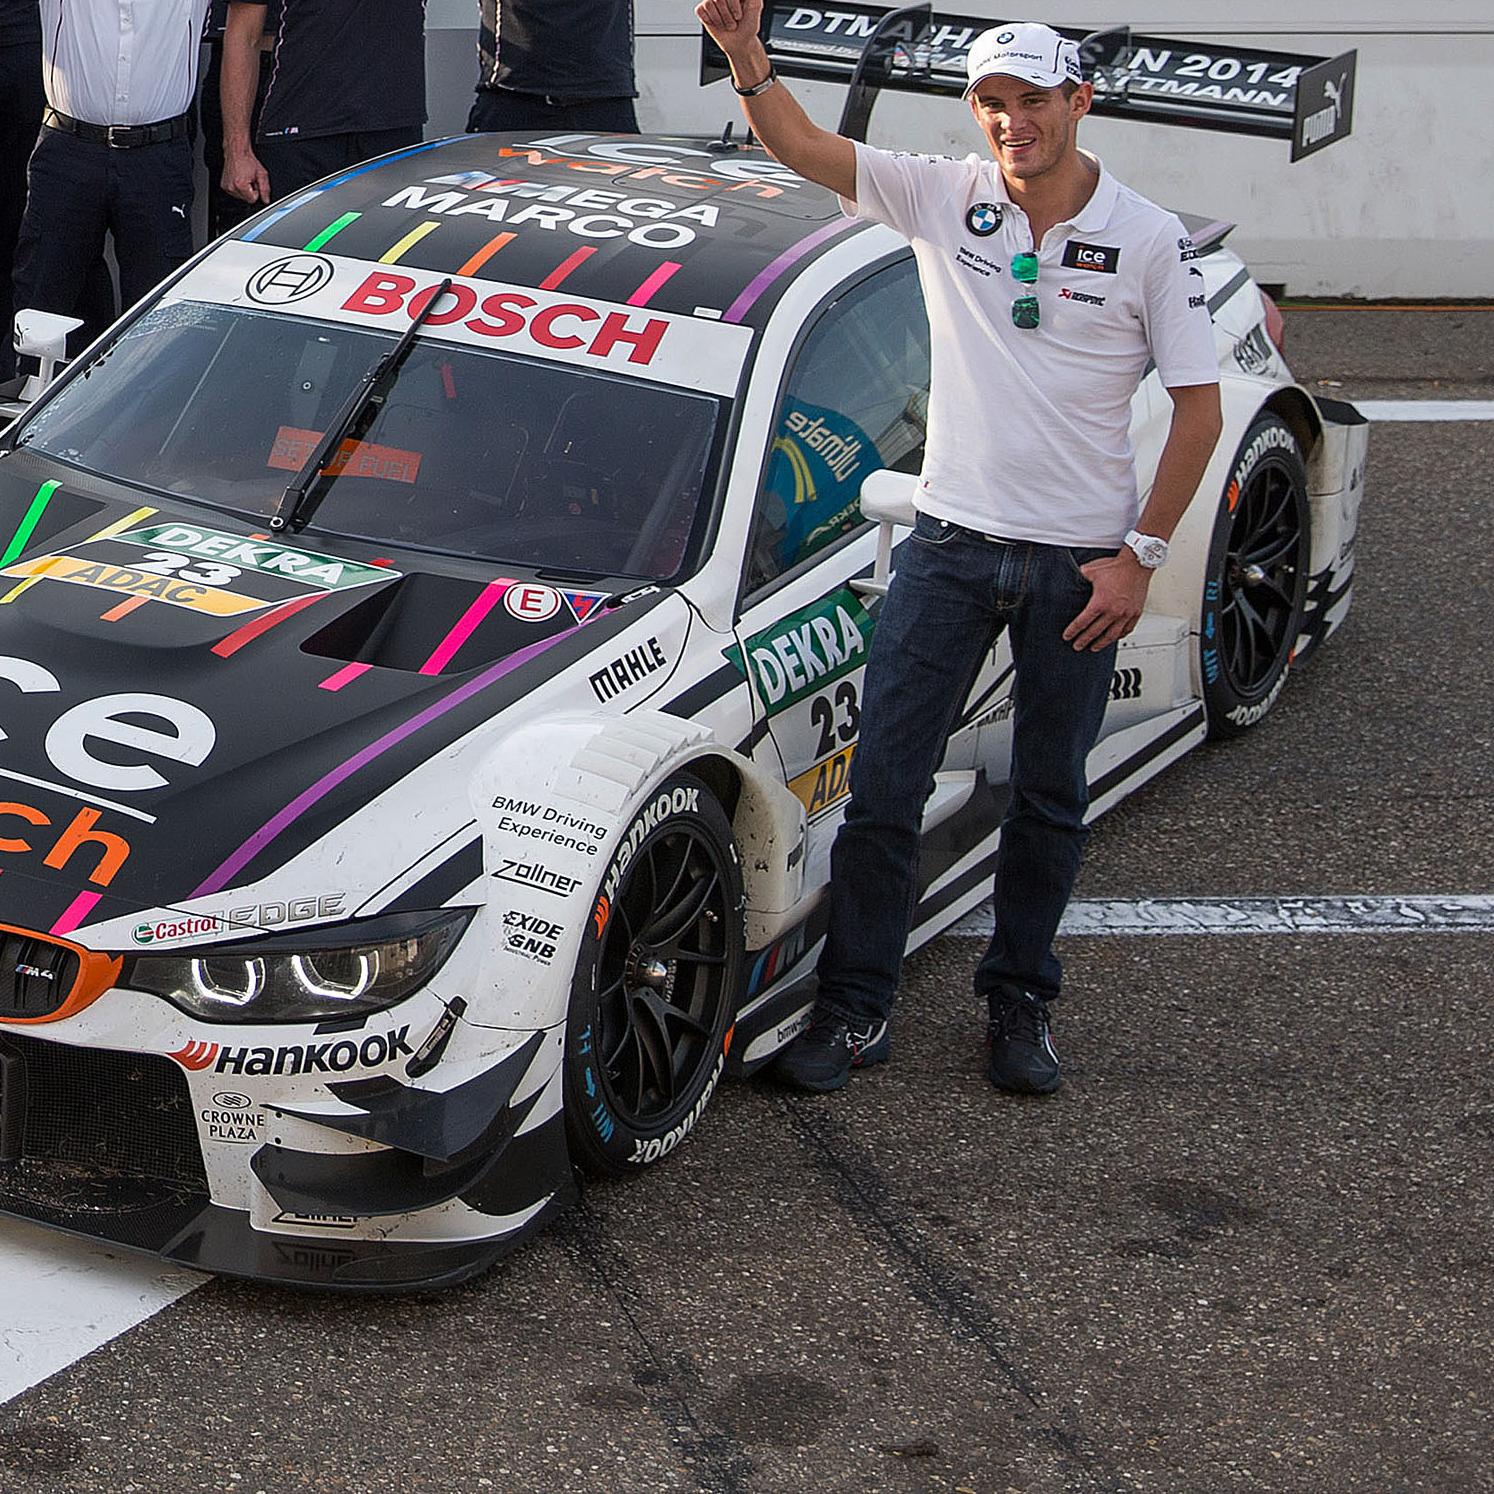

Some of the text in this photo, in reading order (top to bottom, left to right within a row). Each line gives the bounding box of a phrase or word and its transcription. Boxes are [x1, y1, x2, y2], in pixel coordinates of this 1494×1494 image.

[1176, 55, 1304, 89] 2014
[381, 186, 697, 249] MARCO
[974, 254, 1002, 274] Driving
[1077, 245, 1106, 263] ice
[340, 271, 670, 366] BOSCH
[358, 456, 415, 483] FUEL
[143, 551, 243, 588] 23
[158, 524, 347, 585] DEKRA
[65, 564, 212, 608] ADAC
[522, 589, 546, 617] E
[587, 637, 668, 704] MAHLE
[756, 605, 865, 705] DEKRA
[811, 680, 861, 760] 23
[490, 795, 608, 842] BMW Driving
[498, 817, 599, 857] Experience
[154, 892, 349, 943] Castrol EDGE
[503, 910, 565, 941] EXIDE
[508, 934, 557, 959] GNB
[201, 1110, 265, 1129] CROWNE
[208, 1126, 258, 1142] PLAZA
